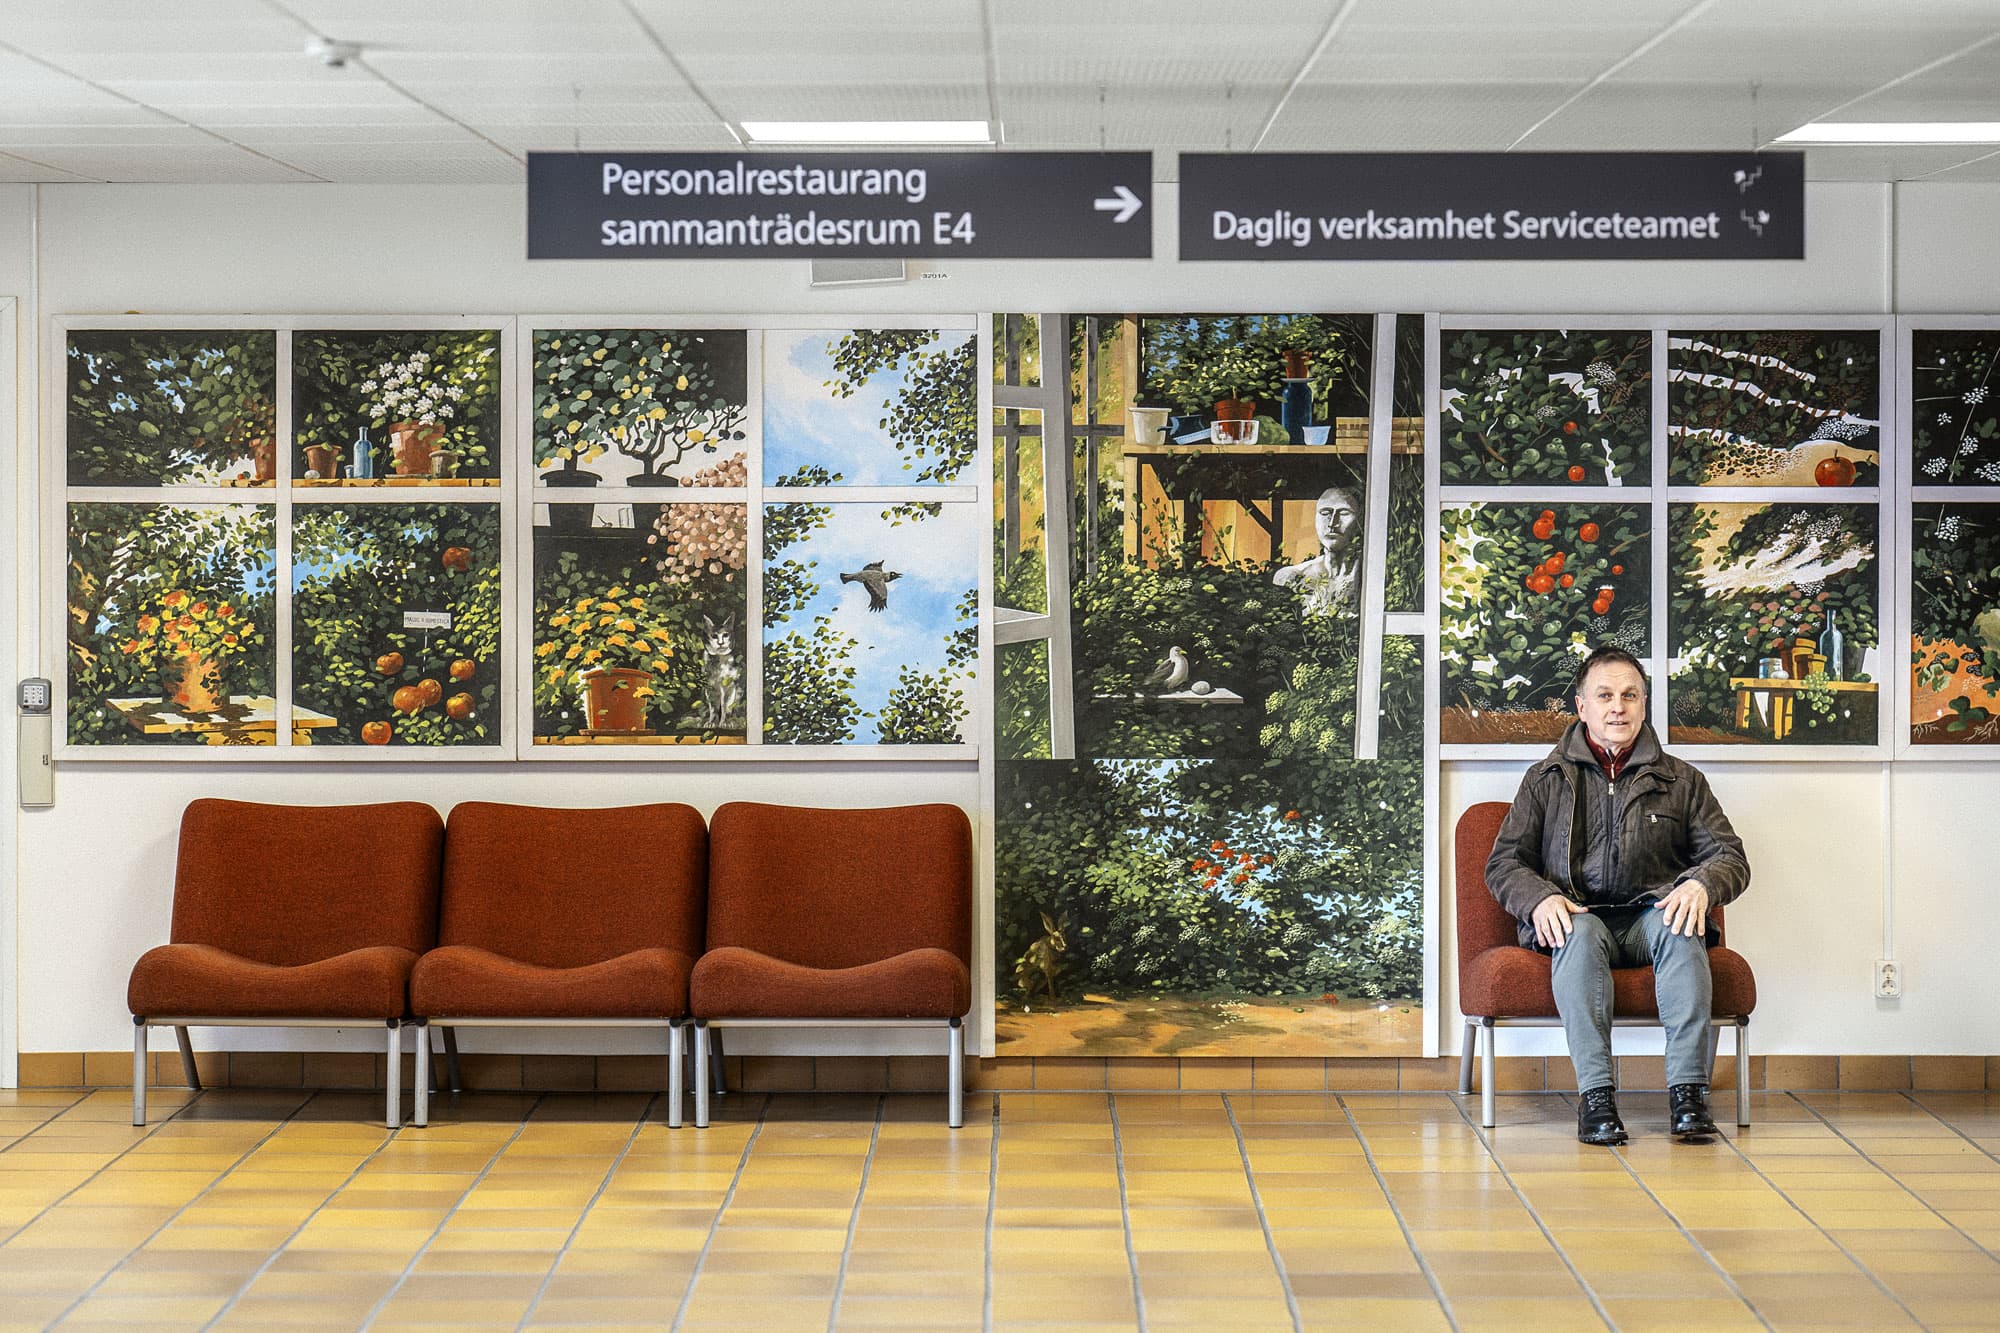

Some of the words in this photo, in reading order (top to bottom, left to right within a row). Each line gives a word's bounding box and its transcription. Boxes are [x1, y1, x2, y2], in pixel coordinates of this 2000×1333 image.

[601, 160, 927, 204] Personalrestaurang
[600, 210, 921, 246] sammanträdesrum
[933, 211, 976, 245] E4
[1213, 209, 1311, 247] Daglig
[1318, 209, 1496, 240] verksamhet
[1503, 209, 1720, 239] Serviceteamet
